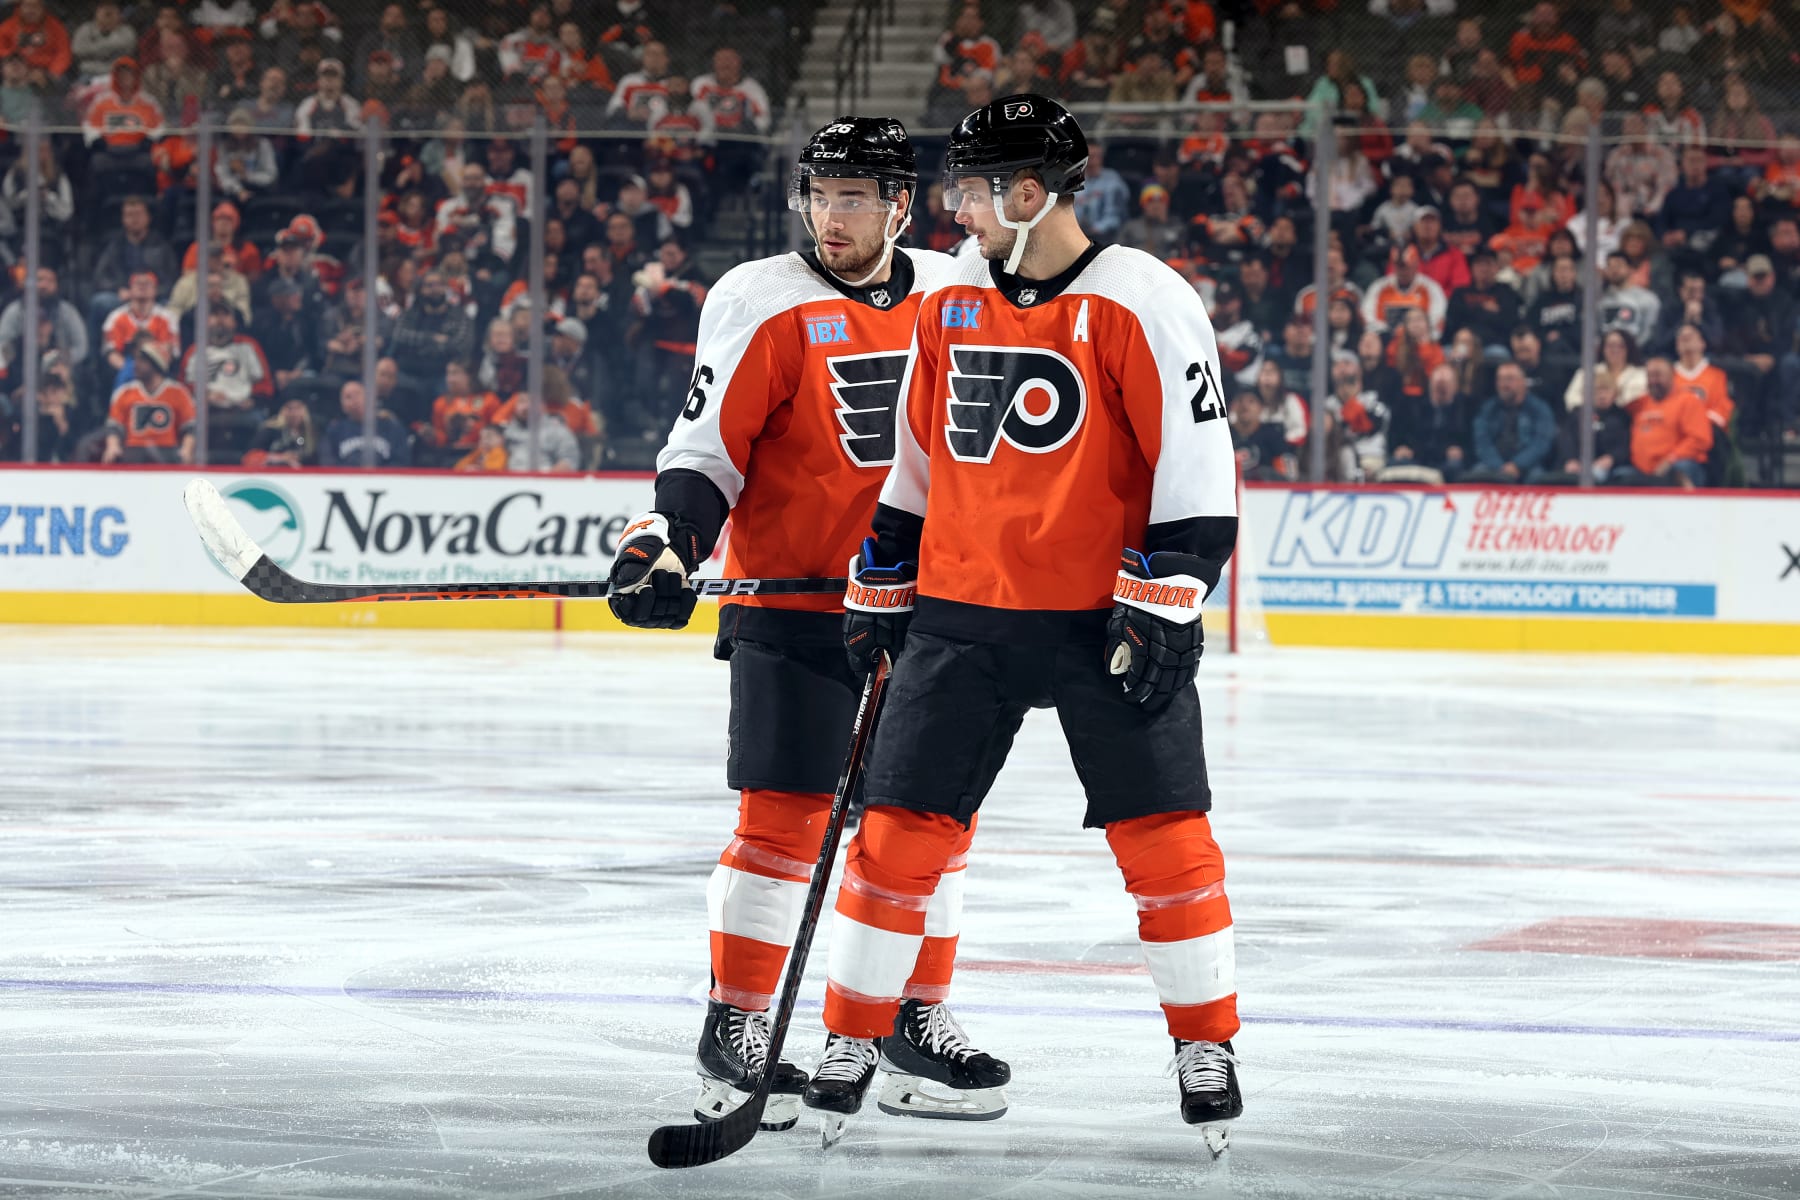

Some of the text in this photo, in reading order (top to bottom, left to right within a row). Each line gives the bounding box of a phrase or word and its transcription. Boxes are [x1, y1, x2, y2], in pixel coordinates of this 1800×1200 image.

[825, 123, 855, 134] 26
[813, 151, 847, 159] CCM
[941, 306, 980, 329] IBX
[1073, 300, 1089, 342] A
[807, 320, 849, 345] IBX
[1473, 490, 1557, 522] OFFICE
[312, 489, 630, 557] NovaCare
[1269, 491, 1458, 569] KDI
[1465, 523, 1624, 554] TECHNOLOGY
[312, 562, 350, 581] The
[357, 563, 420, 582] Power
[427, 562, 447, 582] of
[453, 564, 538, 583] Physical
[1448, 584, 1575, 608] TECHNOLOGY
[1577, 586, 1677, 610] TOGETHER
